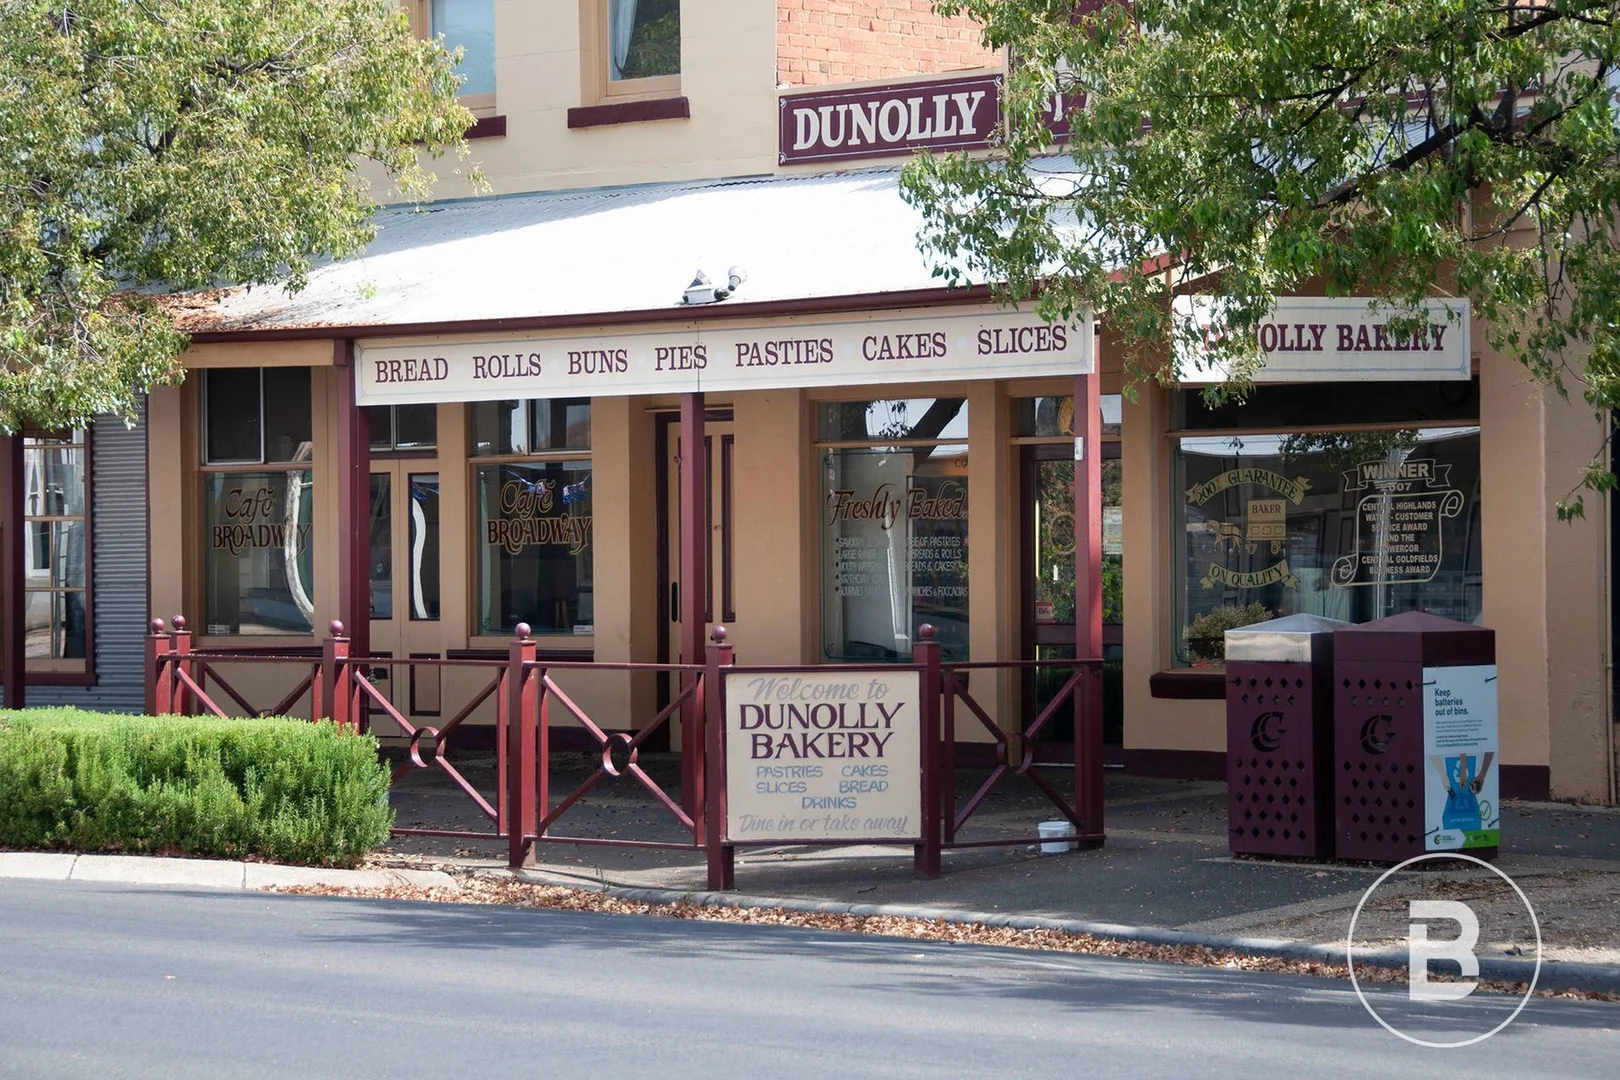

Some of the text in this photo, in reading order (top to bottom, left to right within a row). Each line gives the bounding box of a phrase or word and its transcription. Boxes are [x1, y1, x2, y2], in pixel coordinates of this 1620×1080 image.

[793, 91, 986, 151] DUNOLLY
[1201, 323, 1327, 352] DOLLY
[375, 325, 1068, 383] BREAD ROLLS BUNS PIES PASTIES CAKES SLICES
[1363, 463, 1430, 480] WINNER
[1195, 470, 1298, 504] 200 GUARANTEE
[1380, 482, 1412, 492] 2007
[826, 483, 901, 531] Freshly
[1252, 504, 1282, 514] BAKER
[1362, 501, 1437, 511] CENTRAL HIGHLANDS
[1366, 513, 1389, 522] WATER
[1395, 512, 1433, 521] CUSTOMER
[487, 513, 592, 555] BROADWAY
[1402, 523, 1428, 531] AWARD
[212, 519, 312, 558] BROADWY
[930, 536, 960, 547] PASTRIES
[1401, 534, 1415, 542] THE
[941, 549, 962, 559] ROLLS
[1362, 555, 1438, 564] CENTRAL GOLDFIELDS
[934, 561, 955, 572] CAKES
[1369, 565, 1431, 574] BUSINESS AWARD
[1211, 564, 1283, 587] ON QUALITY
[747, 677, 891, 701] Welcome to
[1434, 688, 1451, 698] Keep
[1434, 697, 1463, 706] batteries
[739, 702, 906, 730] DUNOLLY
[1435, 706, 1469, 716] out of bins.
[750, 732, 895, 759] BAKERY
[756, 764, 889, 779] PASTRIES CAKES
[756, 780, 889, 794] SLICES BREAD
[801, 796, 857, 810] DRINKS
[738, 814, 909, 835] Dine in or take away
